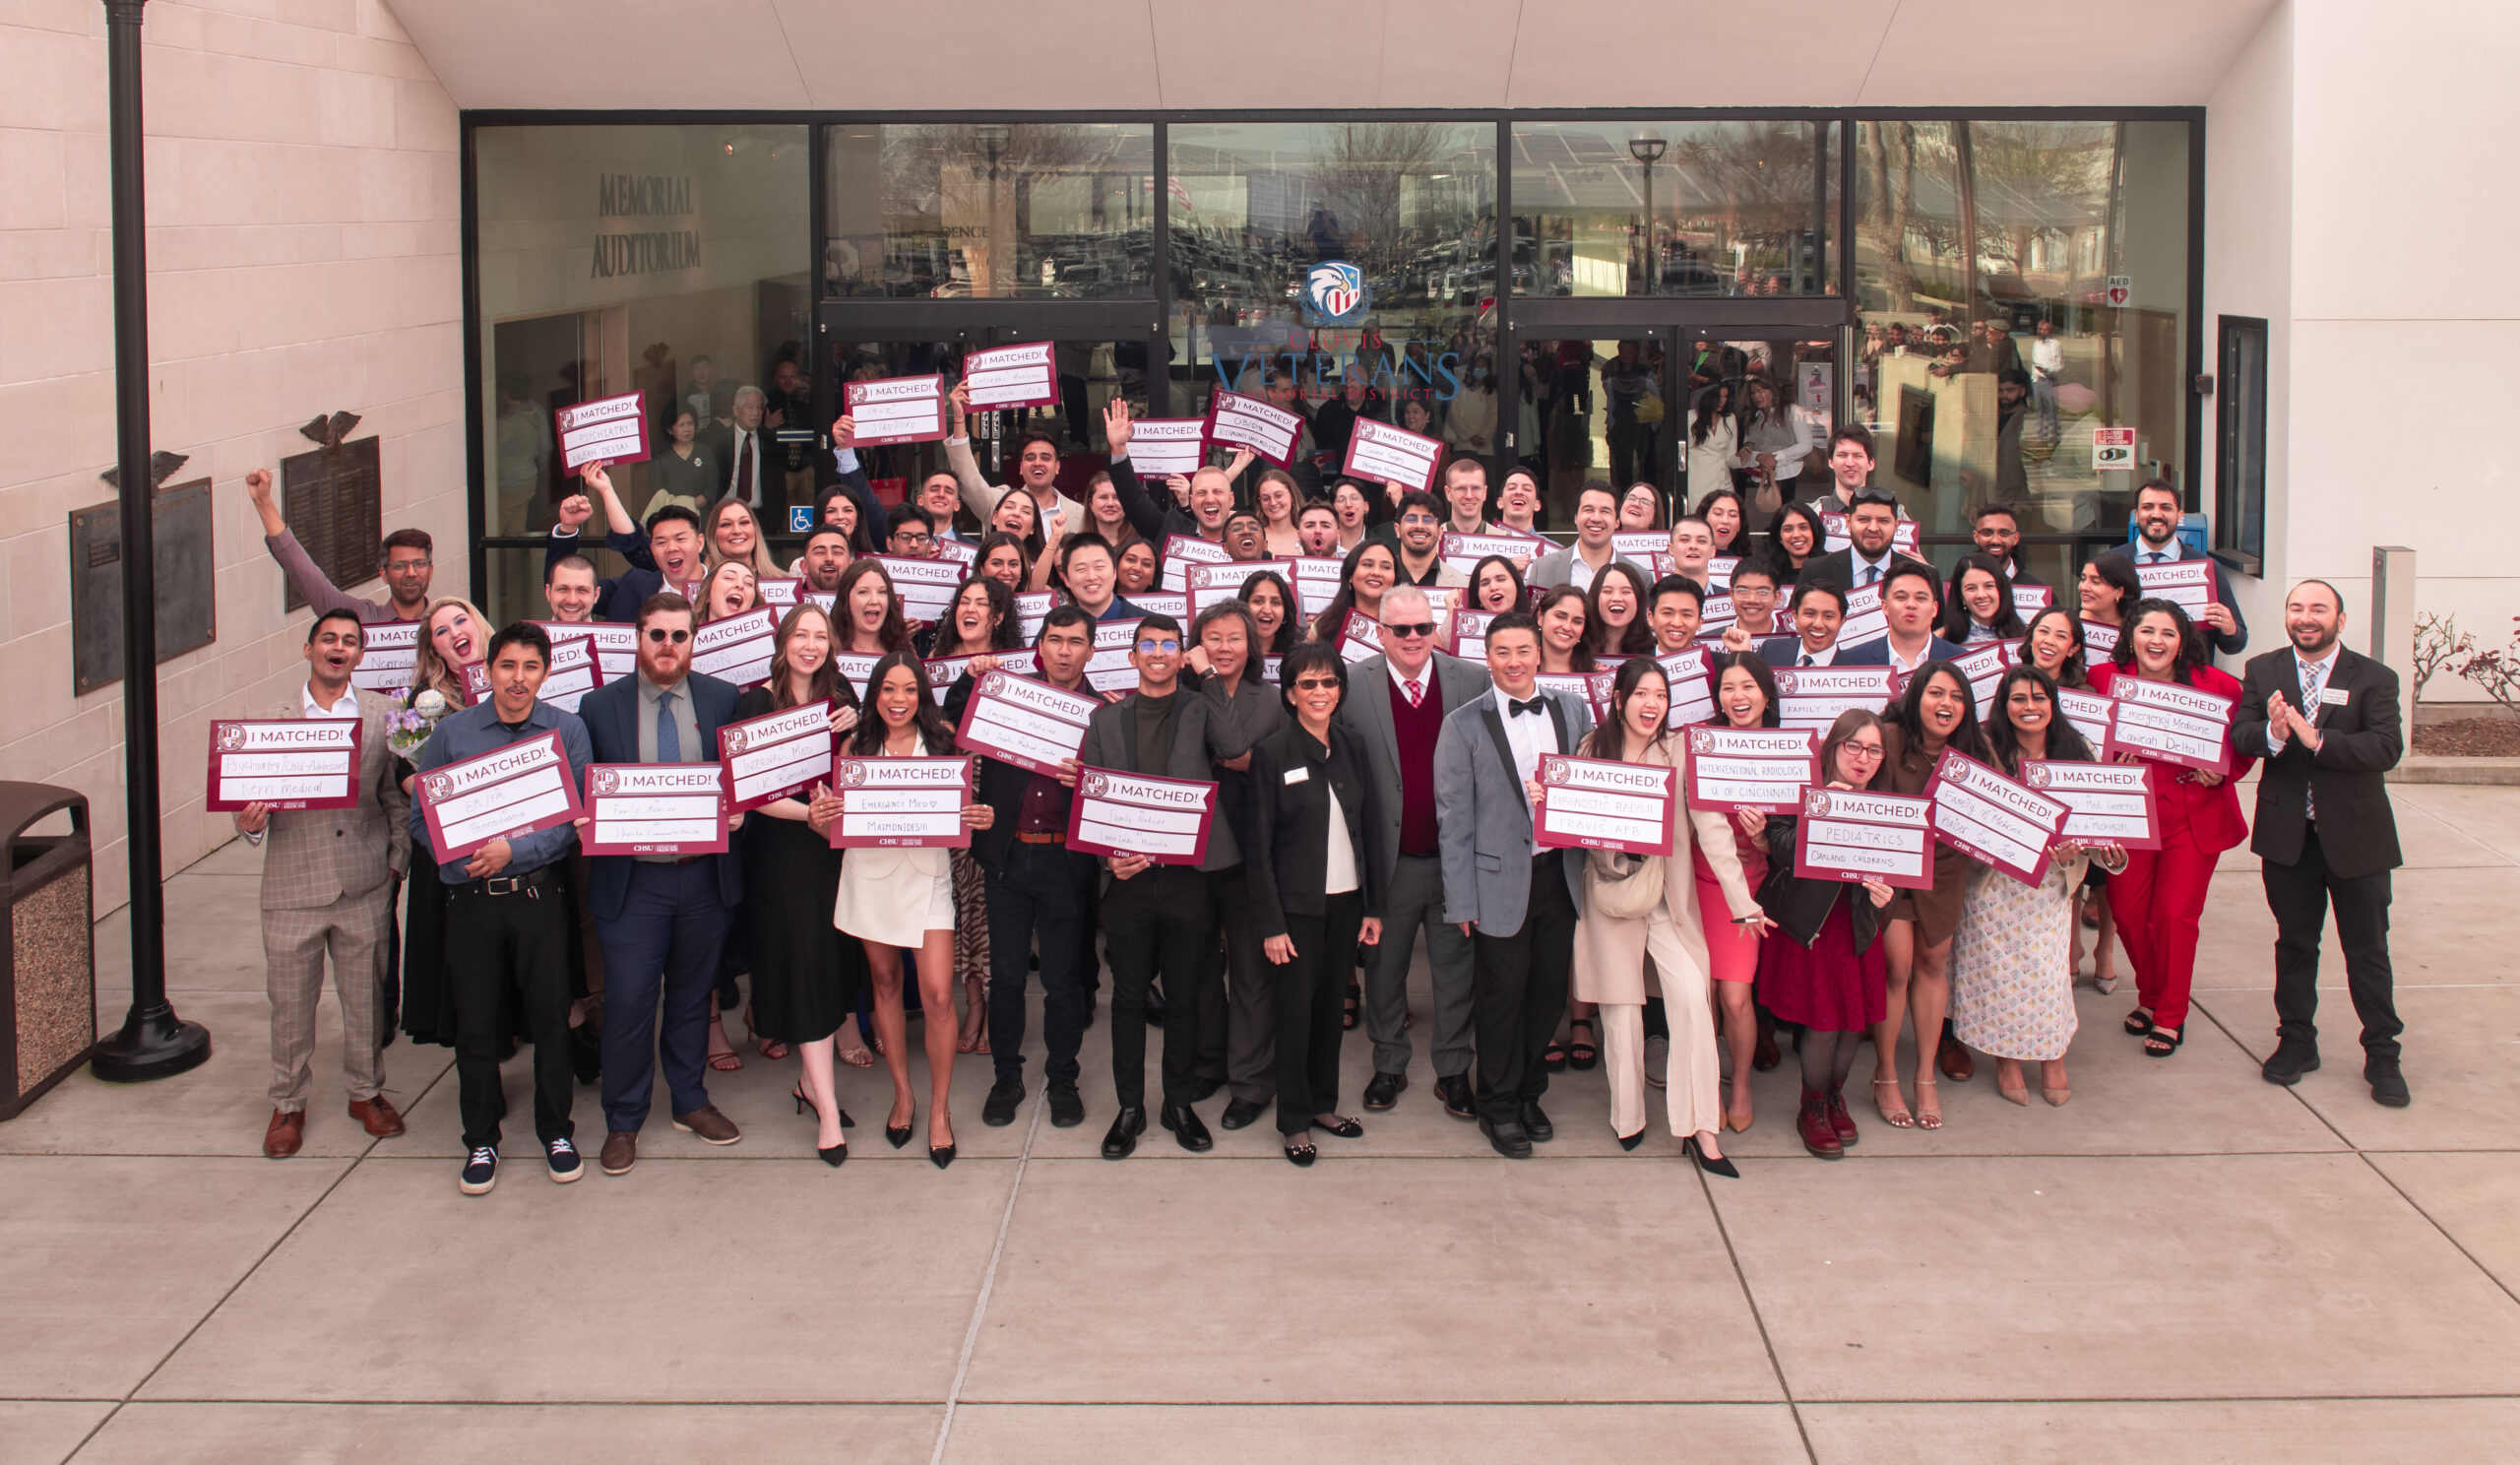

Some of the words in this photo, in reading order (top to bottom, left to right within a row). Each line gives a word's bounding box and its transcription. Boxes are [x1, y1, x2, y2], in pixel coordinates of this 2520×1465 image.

[598, 172, 694, 217] MEMORIAL
[591, 230, 701, 279] AUDITORIUM
[2110, 277, 2129, 286] AED
[1290, 333, 1383, 350] CLOVIS
[990, 350, 1041, 363] MATCHED!
[1210, 352, 1460, 402] VETERANS
[876, 383, 931, 397] MATCHED!
[1354, 389, 1433, 402] DISTRICT
[581, 402, 633, 420] MATCHED!
[1242, 403, 1292, 427] MATCHED!
[1143, 426, 1197, 435] MATCHED!
[1382, 432, 1431, 453] MATCHED!
[1474, 544, 1533, 554] MATCHED!
[1617, 539, 1670, 547] MATCHED
[1191, 546, 1231, 562] MATCHE
[892, 565, 954, 578] MATCHED!
[1307, 565, 1339, 575] MATC
[2138, 569, 2199, 582] MATCHED!
[1137, 601, 1186, 611] ATCHED!
[380, 630, 418, 642] MATC
[697, 618, 764, 646] MATCHED!
[1809, 677, 1881, 688] MATCHED!
[1015, 685, 1085, 718] MATCHED!
[2060, 699, 2103, 715] CHED!
[2149, 689, 2222, 714] MATCHED!
[1788, 705, 1821, 714] FAMILY
[757, 712, 823, 739] MATCHED!
[2118, 705, 2170, 728] Emergency
[2173, 717, 2212, 735] Medicine
[260, 730, 345, 742] MATCHED!
[2116, 725, 2158, 747] Kaweah
[1727, 738, 1802, 750] MATCHED!
[466, 746, 547, 783] MATCHED!
[1698, 763, 1759, 777] INTERVENTIONAL
[1761, 766, 1803, 777] RADIOLOGY
[633, 774, 712, 787] MATCHED!
[879, 768, 956, 780] MATCHED!
[1582, 769, 1660, 789] MATCHED!
[2062, 773, 2137, 785] MATCHED!
[242, 782, 275, 796] Kern
[1120, 784, 1199, 803] MATCHED!
[1724, 787, 1734, 796] OF
[1739, 788, 1796, 797] CINCINNATI
[1552, 795, 1609, 810] DIAGNOSTIC
[1944, 790, 1976, 813] Family
[1979, 777, 2052, 820] MATCHED!
[1843, 800, 1920, 819] MATCHED!
[1559, 818, 1606, 832] TRAVIS
[1615, 824, 1641, 836] AFB
[1941, 813, 1969, 834] Kaiser
[1581, 838, 1601, 847] CHSU
[1826, 827, 1905, 846] PEDIATRICS
[1953, 840, 1974, 853] CHSU
[1810, 850, 1847, 862] OAKLAND
[1841, 871, 1861, 880] CHSU
